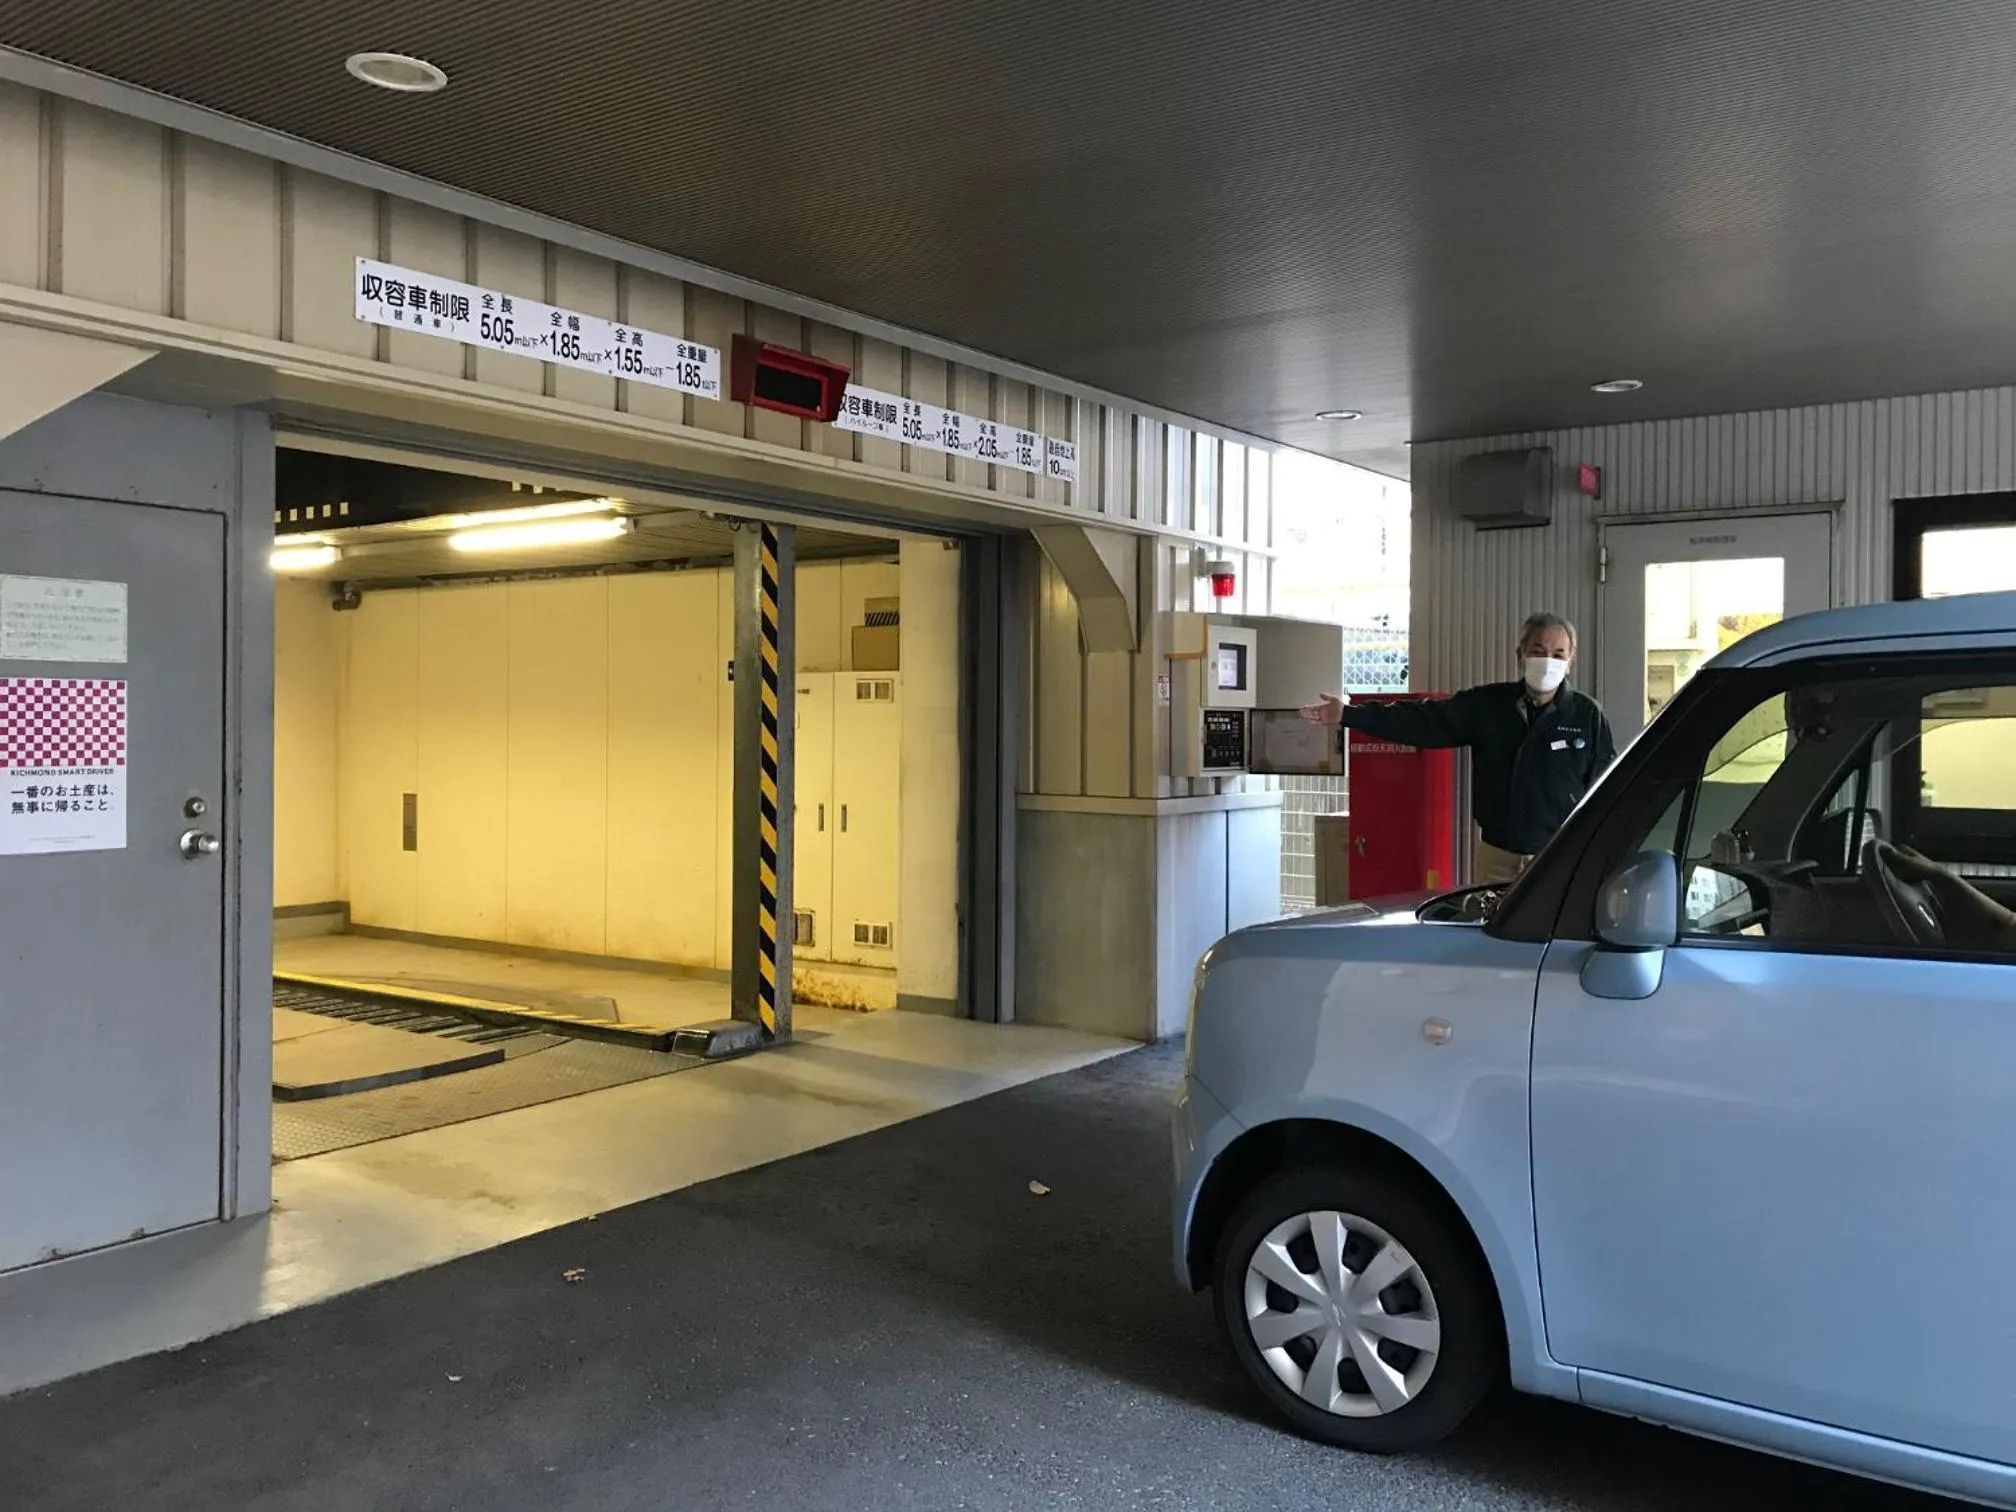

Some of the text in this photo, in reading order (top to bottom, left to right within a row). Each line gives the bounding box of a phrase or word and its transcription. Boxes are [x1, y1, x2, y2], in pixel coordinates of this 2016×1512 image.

[361, 273, 470, 323] 収容車制限
[481, 293, 709, 364] 全長 全幅 全高 全重量
[10, 767, 114, 777] RICHMOND SMART DRIVER
